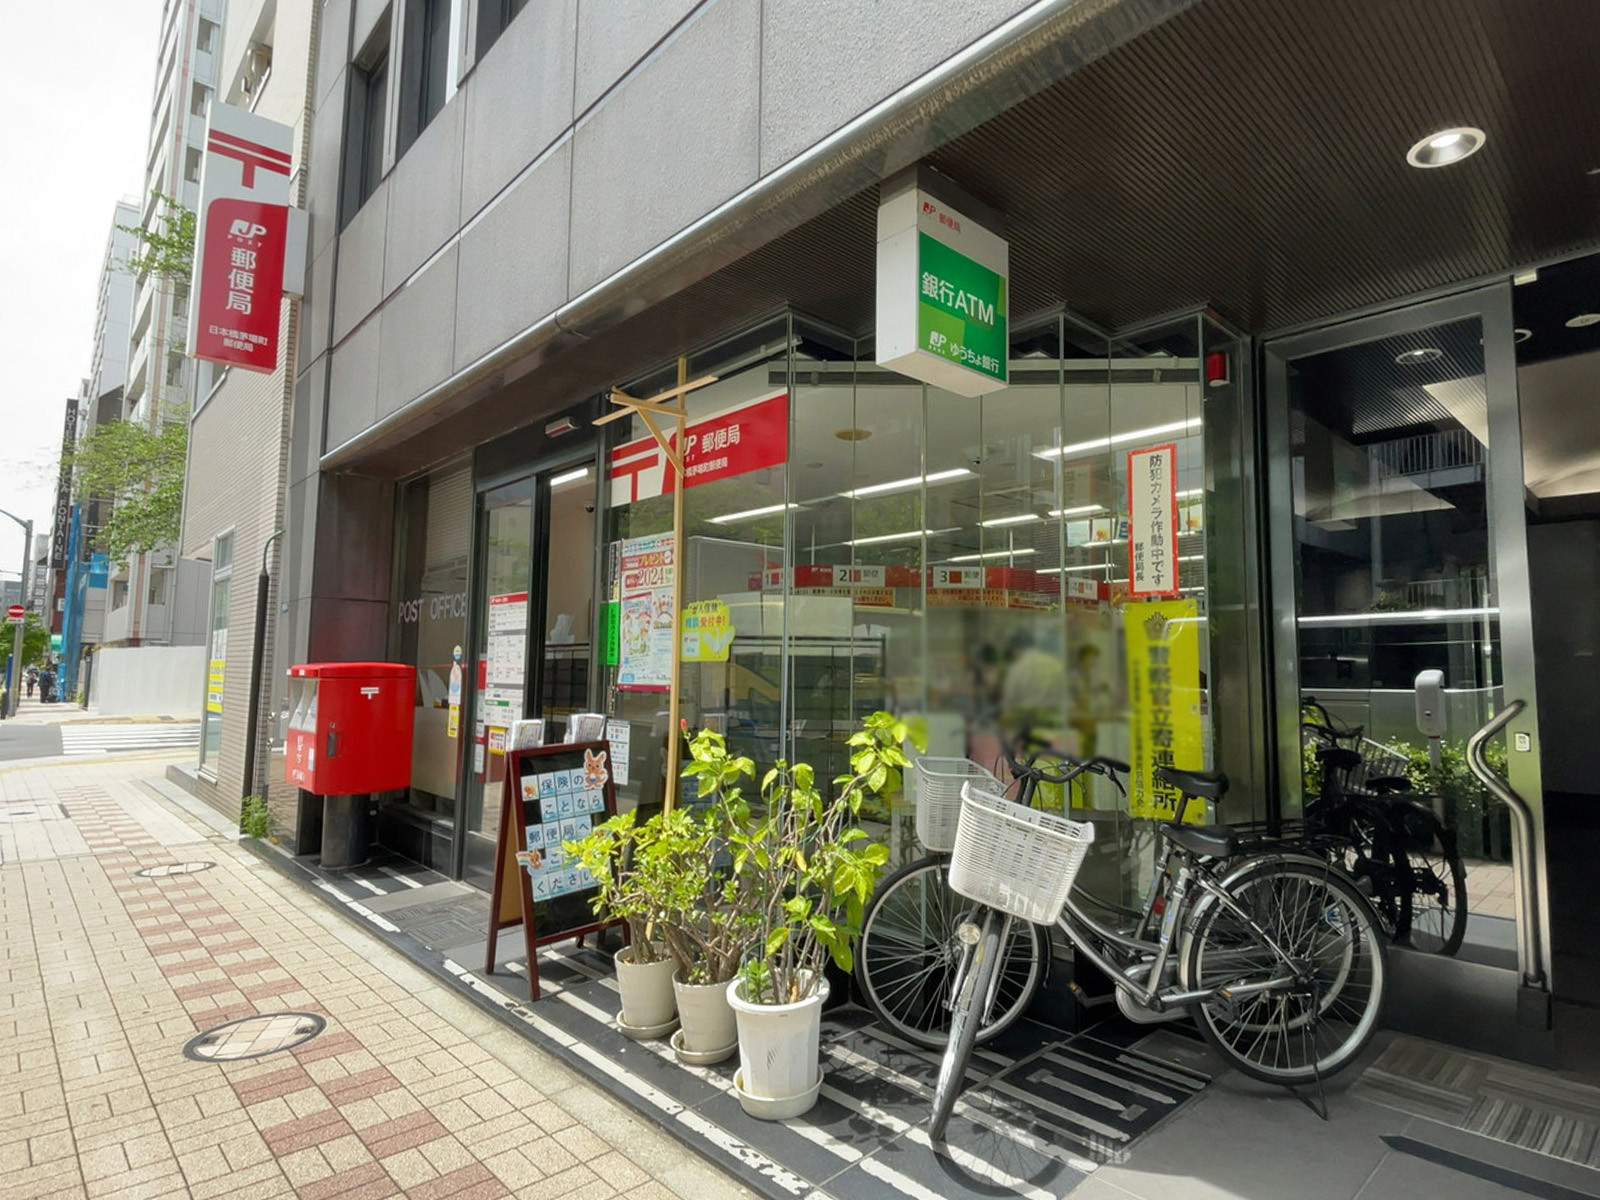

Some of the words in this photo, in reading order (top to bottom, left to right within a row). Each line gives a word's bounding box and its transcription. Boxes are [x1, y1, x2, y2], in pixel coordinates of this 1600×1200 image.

[226, 247, 257, 315] 郵便局
[922, 271, 995, 326] 銀行ATM
[223, 338, 254, 352] 郵便局
[950, 342, 999, 373] ゆうちょ銀行
[702, 424, 740, 454] 郵便局
[1149, 454, 1165, 587] 防犯カメラ作動中です
[839, 569, 848, 582] 2
[939, 570, 948, 582] 3
[397, 599, 424, 624] POST
[430, 592, 467, 620] OFFICE
[541, 774, 584, 791] 保険の
[544, 795, 601, 815] ことなら
[528, 823, 589, 844] 郵便局へ
